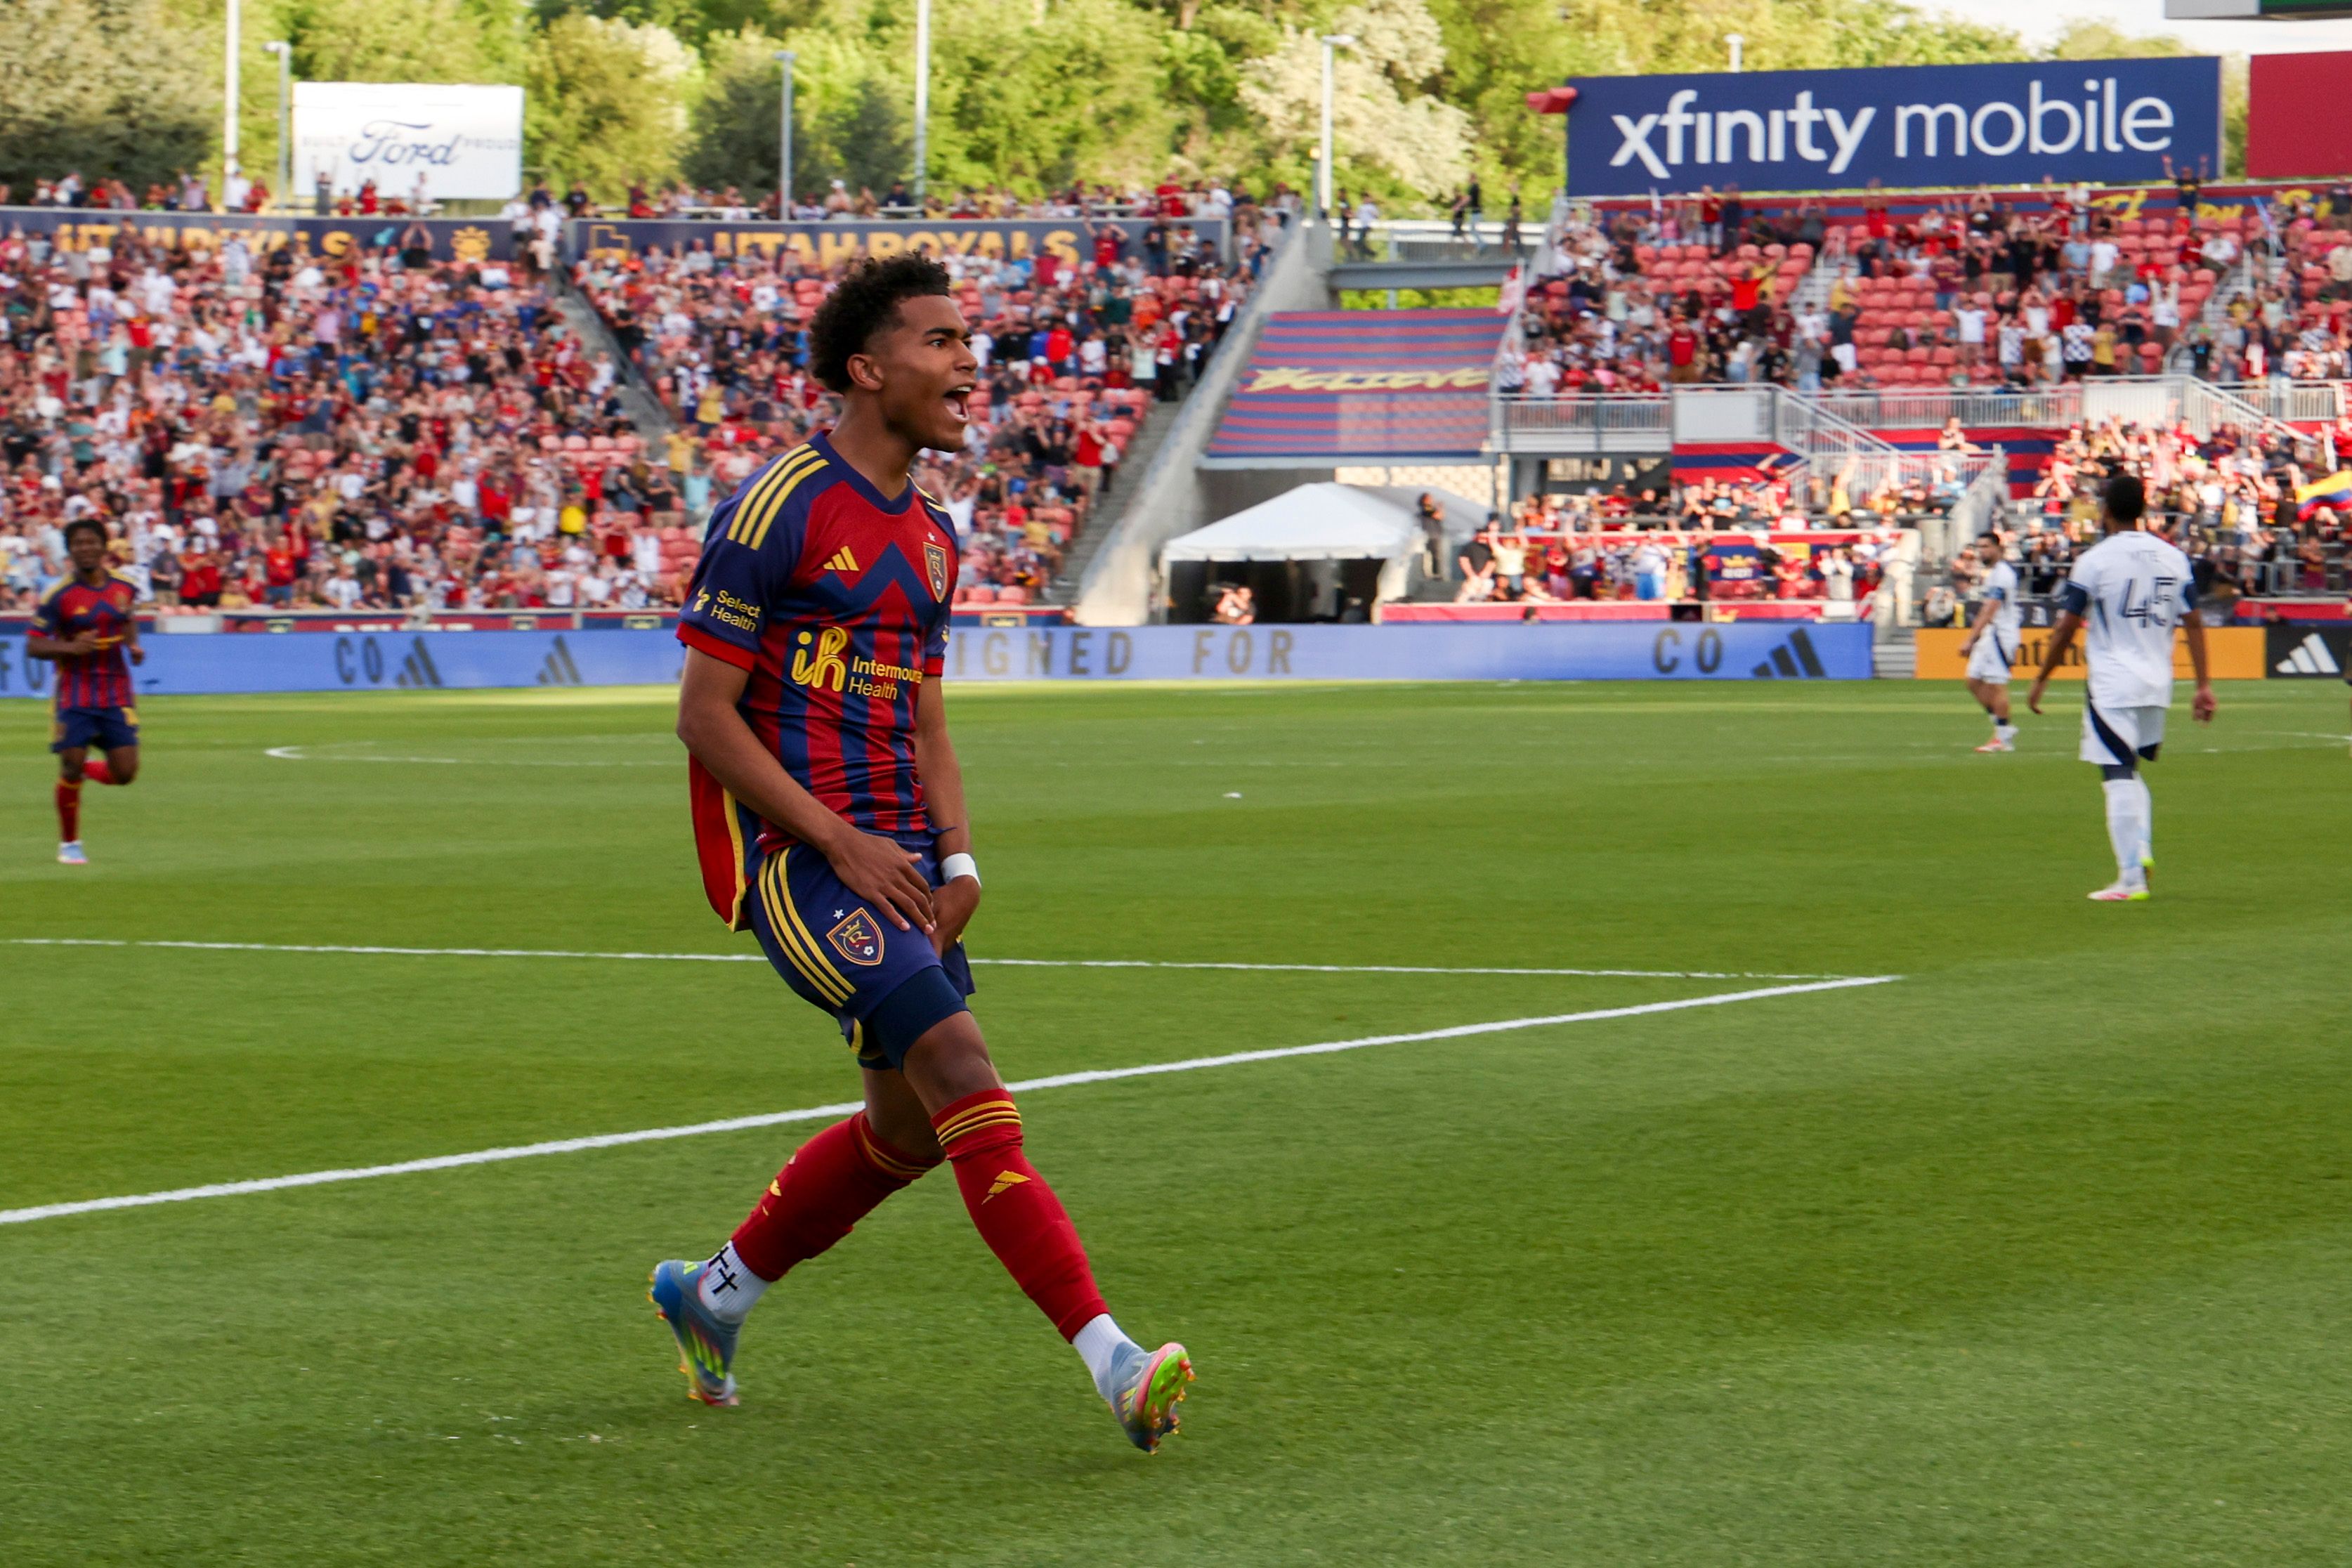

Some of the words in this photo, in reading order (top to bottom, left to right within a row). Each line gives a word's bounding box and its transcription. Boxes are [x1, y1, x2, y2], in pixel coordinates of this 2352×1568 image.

[350, 119, 462, 165] Ford
[1609, 89, 1876, 179] xfinity
[1895, 78, 2174, 159] mobile
[712, 230, 860, 270] UTAH
[865, 230, 1080, 267] ROYALS
[710, 604, 757, 633] Health
[716, 589, 762, 618] Select
[2118, 576, 2177, 628] 45
[851, 655, 924, 685] Intermou
[1192, 628, 1294, 676] FOR
[1653, 627, 1723, 674] CO
[847, 676, 899, 700] Health
